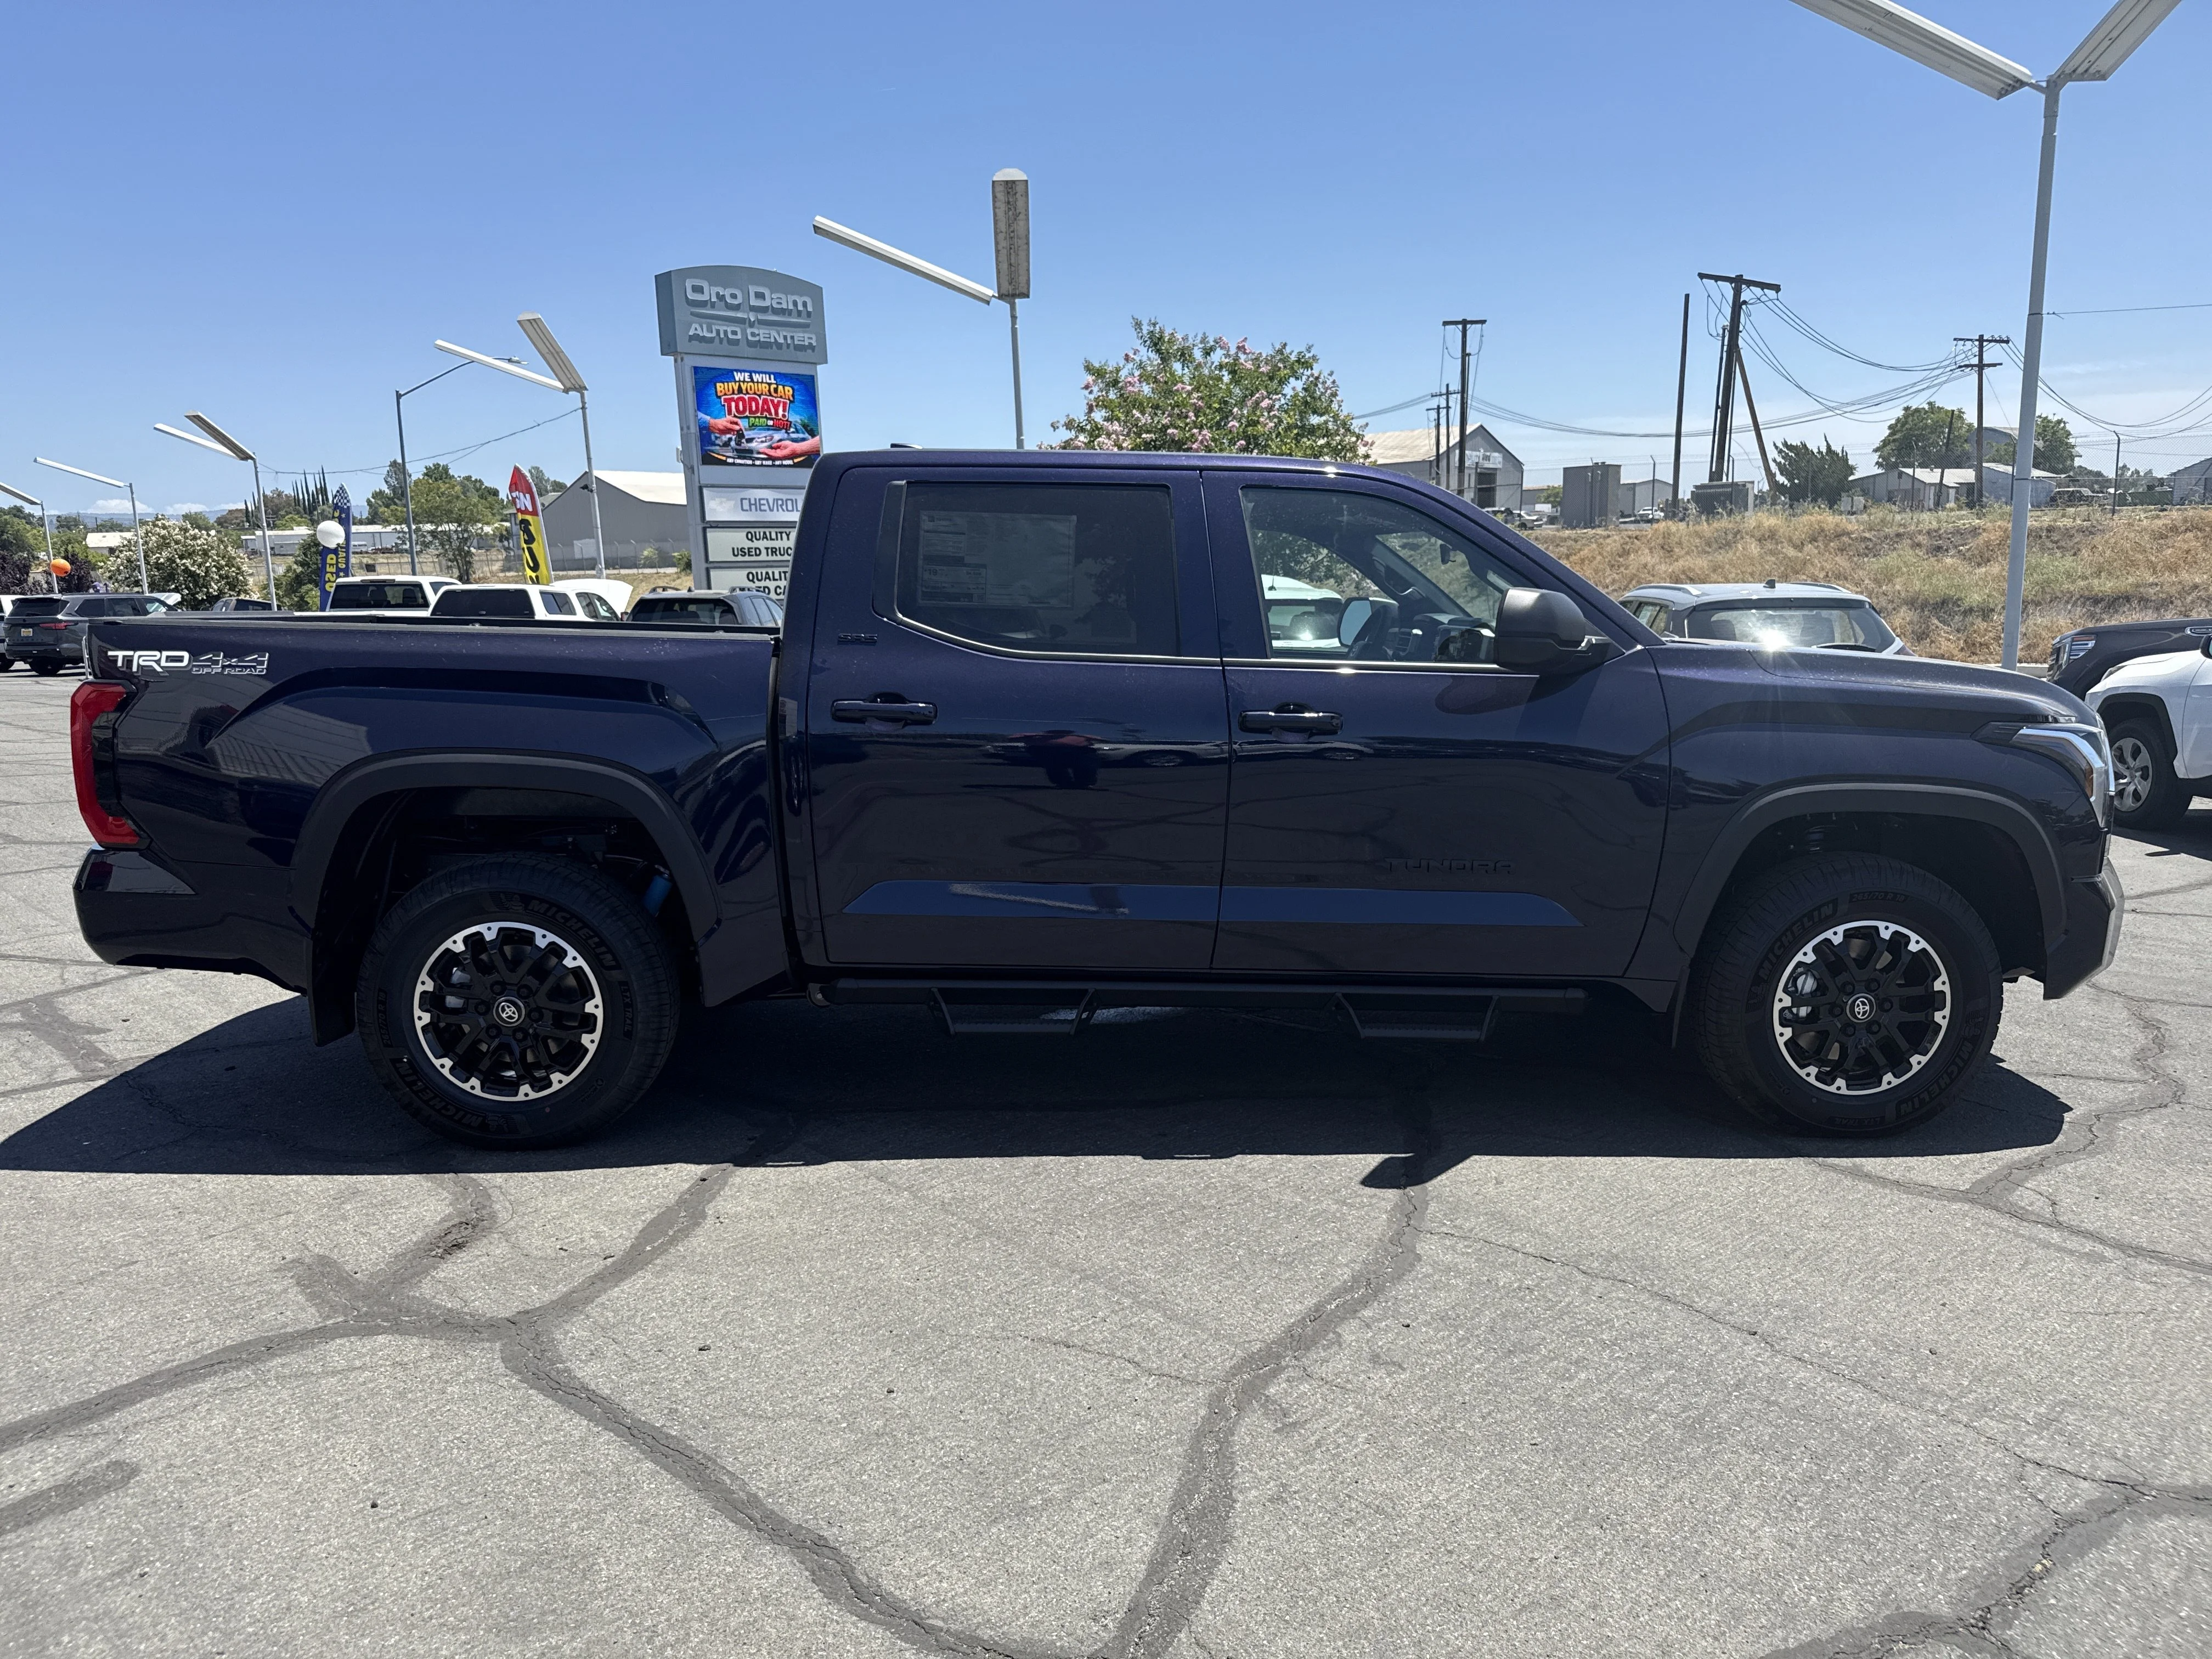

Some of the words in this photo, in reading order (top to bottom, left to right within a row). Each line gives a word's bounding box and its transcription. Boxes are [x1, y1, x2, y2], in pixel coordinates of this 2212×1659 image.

[685, 278, 742, 304] Oro
[748, 285, 813, 312] Dam
[689, 323, 742, 339] AUTO
[747, 328, 817, 346] CENTER
[733, 371, 751, 382] WE
[752, 373, 776, 383] WILL
[716, 382, 739, 396] BUY
[739, 382, 770, 396] YOUR
[770, 384, 793, 400] CAR
[723, 396, 789, 420] TODAY!
[749, 418, 767, 426] PAID
[740, 498, 801, 512] CHEVROL
[746, 531, 791, 543] QUALITY
[732, 546, 762, 557] USED
[764, 546, 793, 557] TRUC
[746, 571, 788, 584] QUALIT
[108, 651, 190, 673] TRD
[193, 651, 269, 668] 4x4
[1384, 857, 1517, 875] TUNDRA
[528, 899, 617, 967] MICHELIN
[1759, 903, 1833, 978] MICHELIN
[620, 986, 632, 1004] LTX
[1900, 1040, 1974, 1118] MICHELIN
[397, 1060, 481, 1128] MICHELIN
